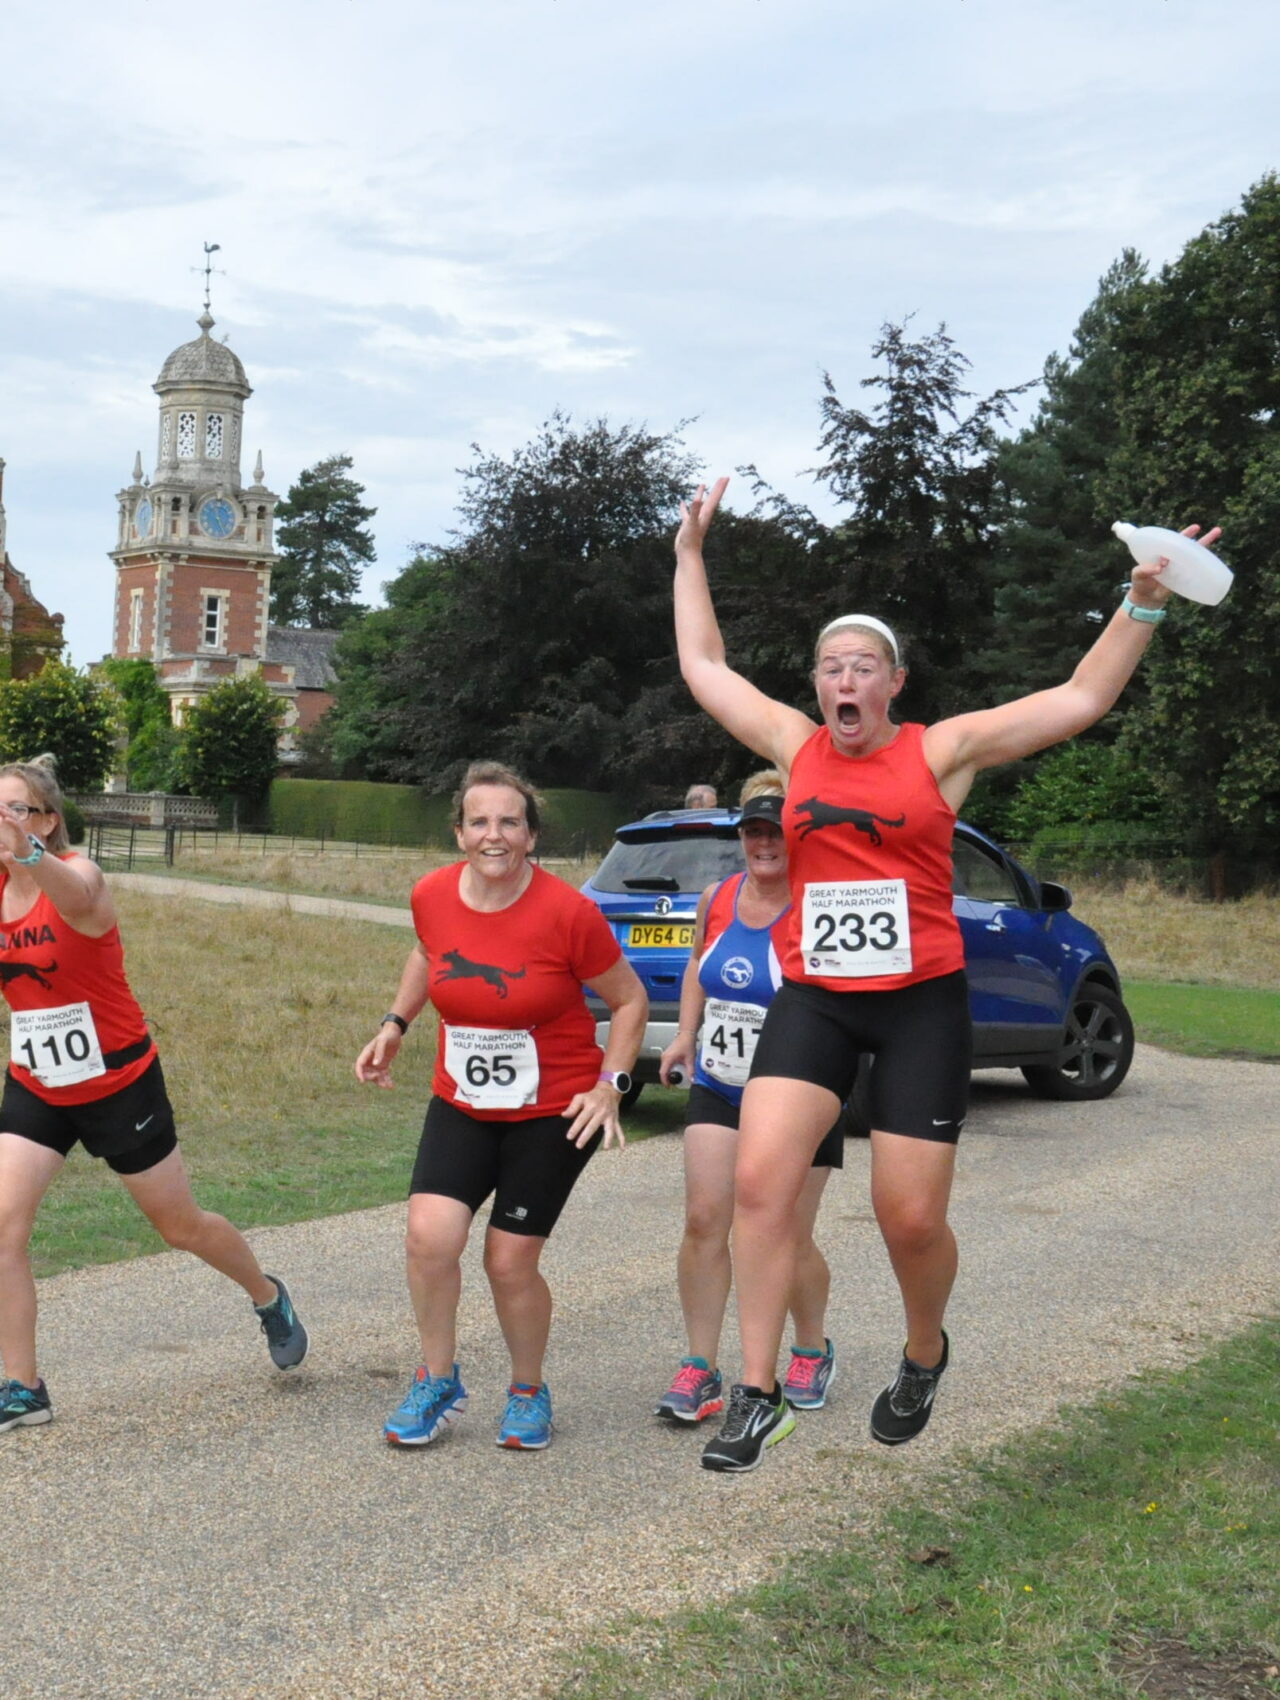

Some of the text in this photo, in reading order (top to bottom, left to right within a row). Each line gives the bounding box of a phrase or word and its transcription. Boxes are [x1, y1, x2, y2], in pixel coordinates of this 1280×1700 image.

[809, 886, 898, 898] GREAT YARMOUTH
[812, 897, 895, 908] HALF MARATHON
[632, 927, 674, 944] DY64
[813, 911, 898, 952] 233
[16, 1008, 83, 1025] GREAT YARMOUTH
[731, 1007, 764, 1018] YARMOU
[35, 1016, 83, 1032] MARATHON
[728, 1015, 764, 1025] MARATHO
[451, 1031, 528, 1042] GREAT YARMOUTH
[21, 1029, 90, 1070] 110
[453, 1041, 526, 1051] HALF MARATHON
[465, 1055, 517, 1087] 65
